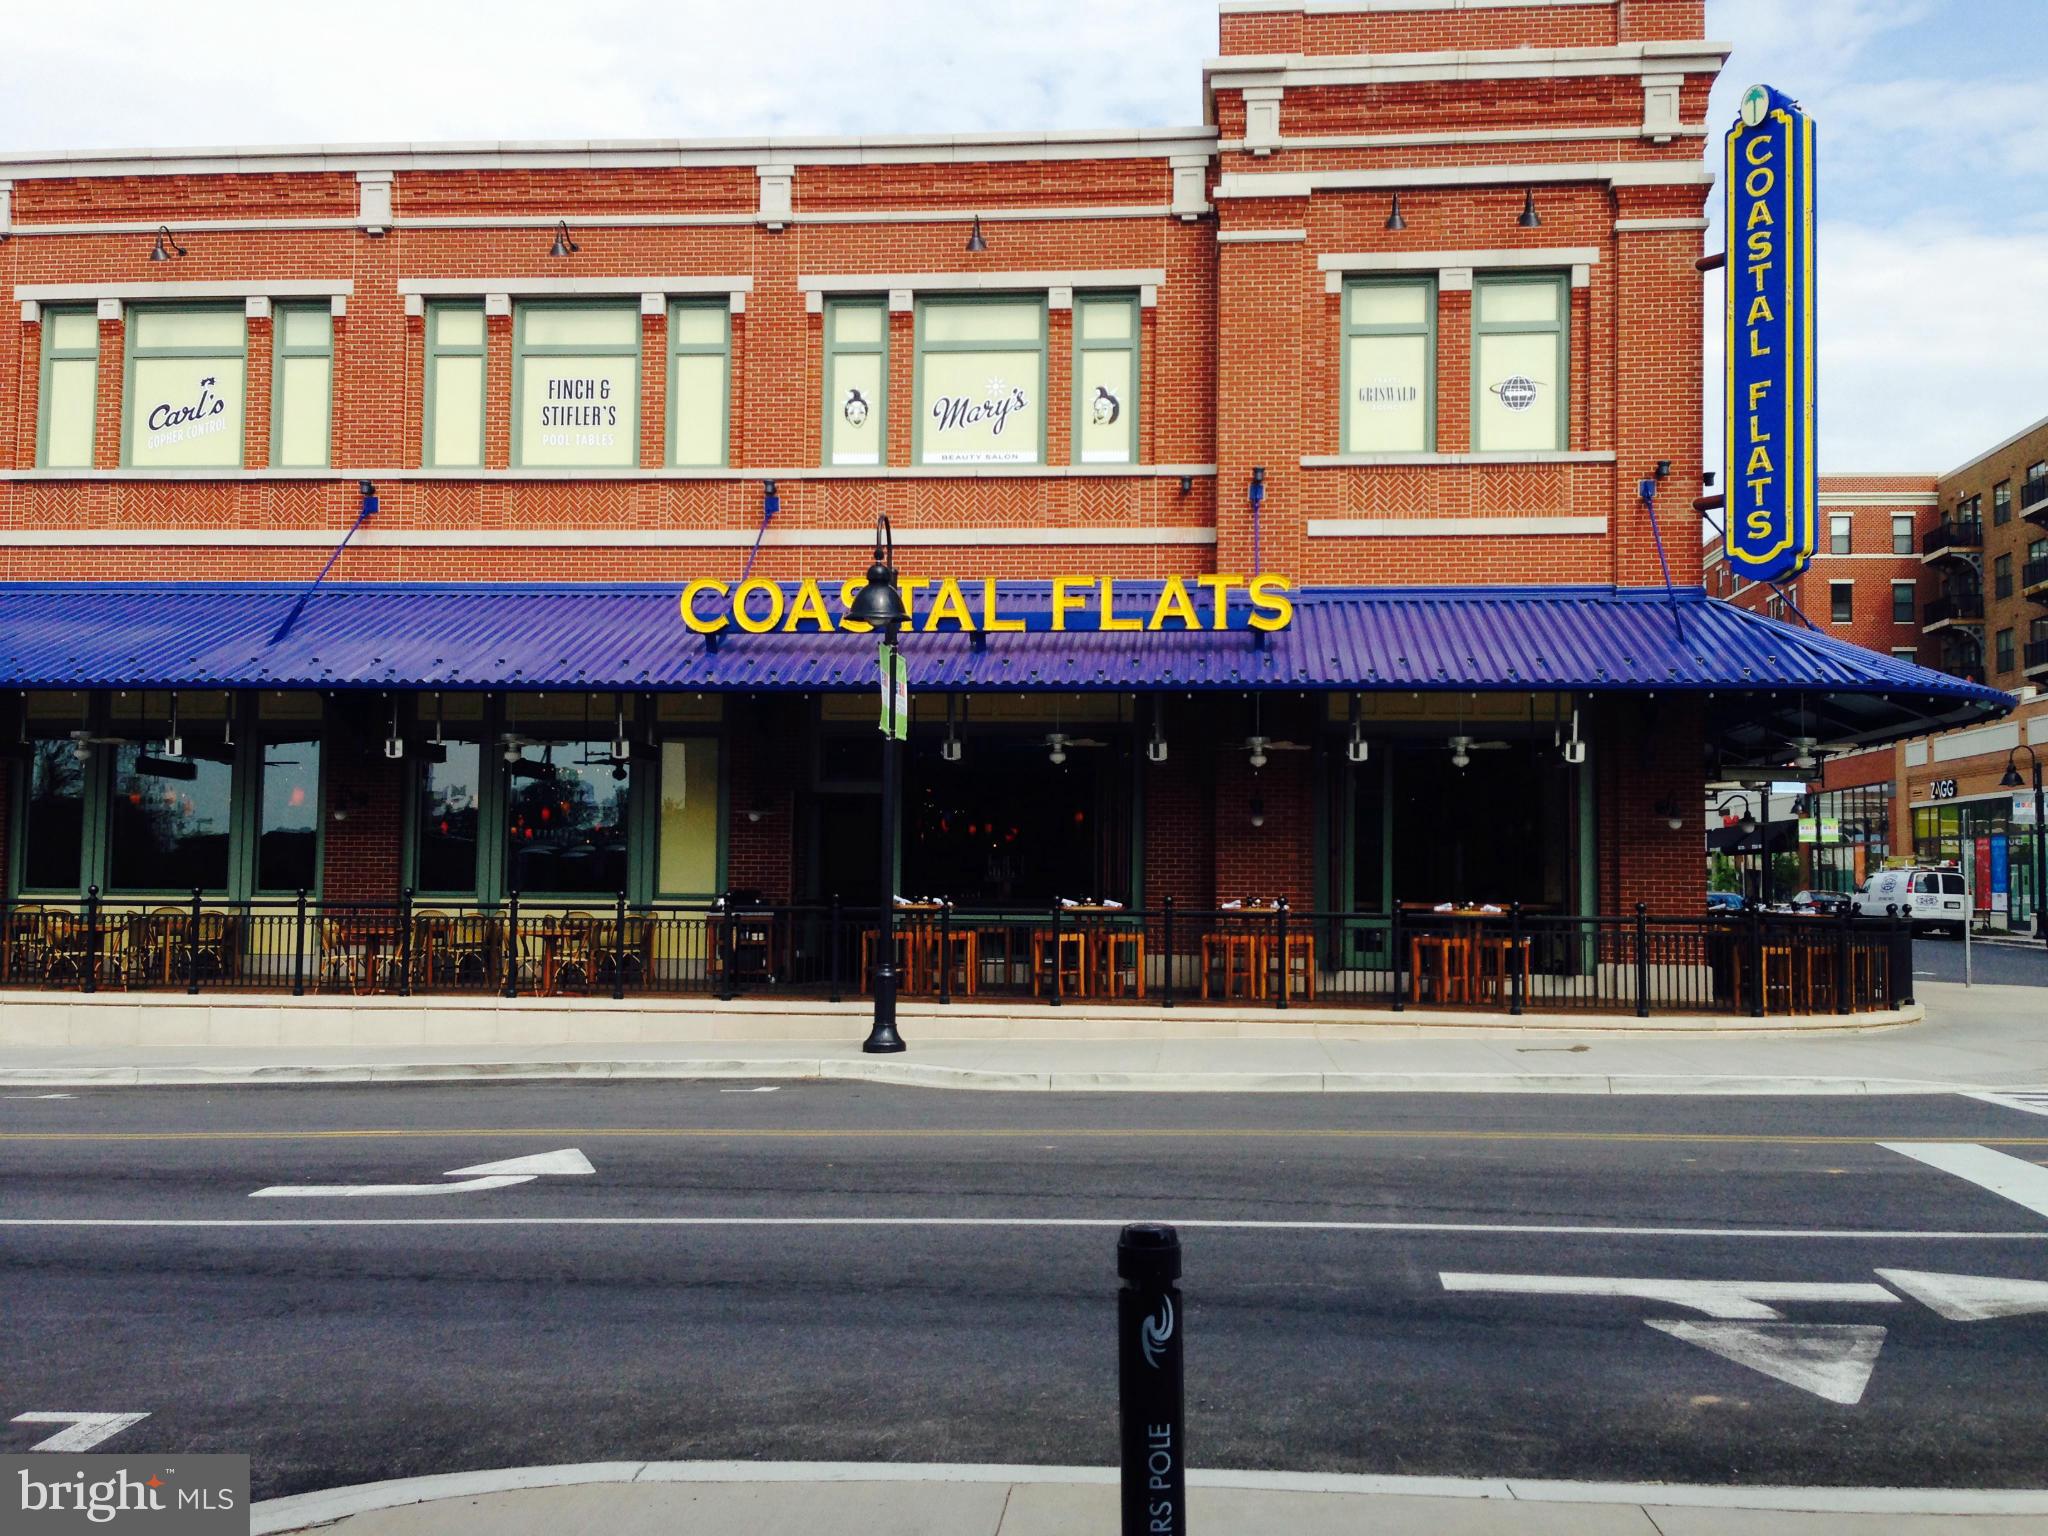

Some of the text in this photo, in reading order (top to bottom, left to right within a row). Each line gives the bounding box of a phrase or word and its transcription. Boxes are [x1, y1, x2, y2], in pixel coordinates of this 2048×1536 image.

[1745, 135, 1775, 357] COASTAL
[548, 379, 611, 399] FINCH &
[148, 390, 225, 431] Carl's
[542, 405, 616, 426] STIFLER'S
[933, 388, 1028, 435] Mary's
[147, 417, 226, 449] GOPHER CONTROL
[543, 433, 614, 446] POOL TABLES
[1745, 380, 1774, 540] FLATS
[680, 575, 1293, 633] COASTAL FLATS
[1930, 780, 1955, 799] ZAGG
[1148, 1424, 1171, 1489] POLE
